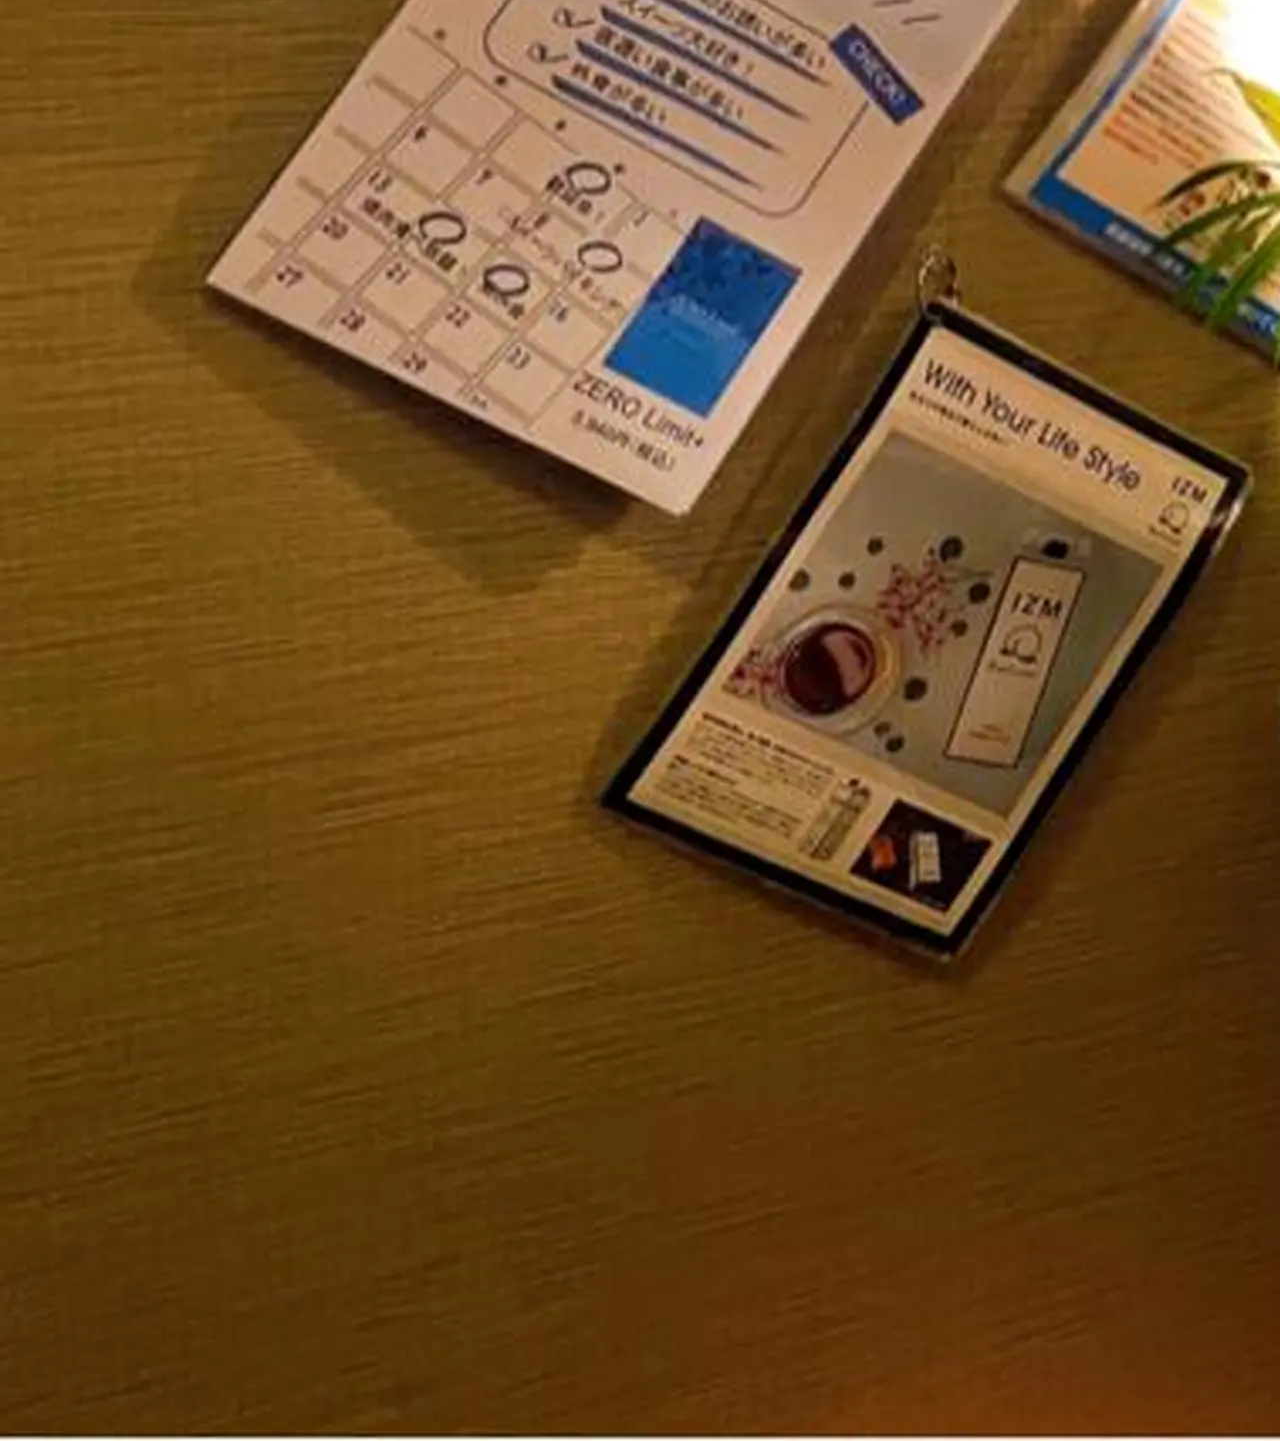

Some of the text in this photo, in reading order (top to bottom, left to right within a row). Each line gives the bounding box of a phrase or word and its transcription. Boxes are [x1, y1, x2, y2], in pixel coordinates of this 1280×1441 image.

[572, 369, 642, 418] ZERO
[923, 359, 978, 406] With
[982, 386, 1034, 436] Your
[1036, 421, 1081, 461] Life
[1083, 445, 1142, 493] Style
[1170, 474, 1209, 503] IZM
